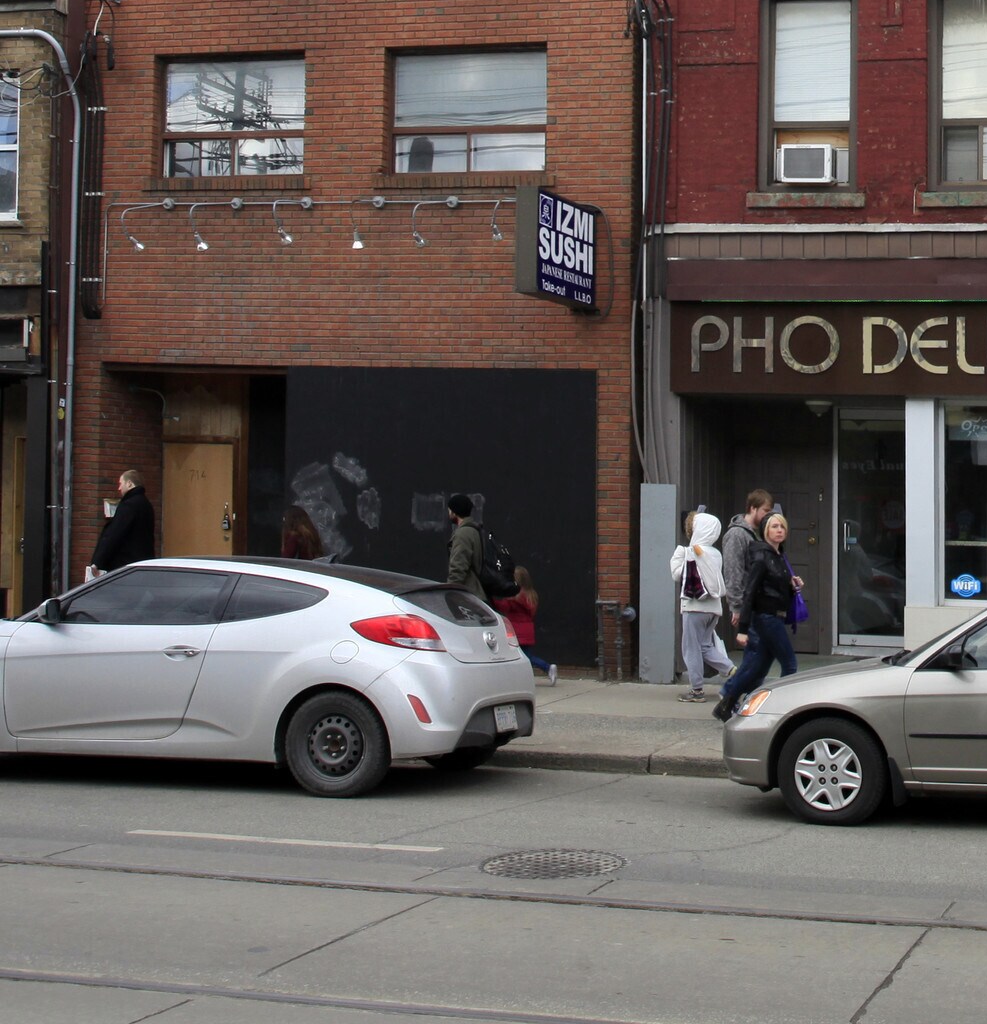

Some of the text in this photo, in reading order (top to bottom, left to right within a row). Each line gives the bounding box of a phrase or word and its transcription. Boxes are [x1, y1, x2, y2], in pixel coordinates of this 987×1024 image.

[556, 200, 594, 244] IZMI
[539, 226, 594, 275] SUSHI
[542, 279, 565, 296] Take-out
[691, 315, 840, 374] PHO
[953, 580, 979, 591] WiFi
